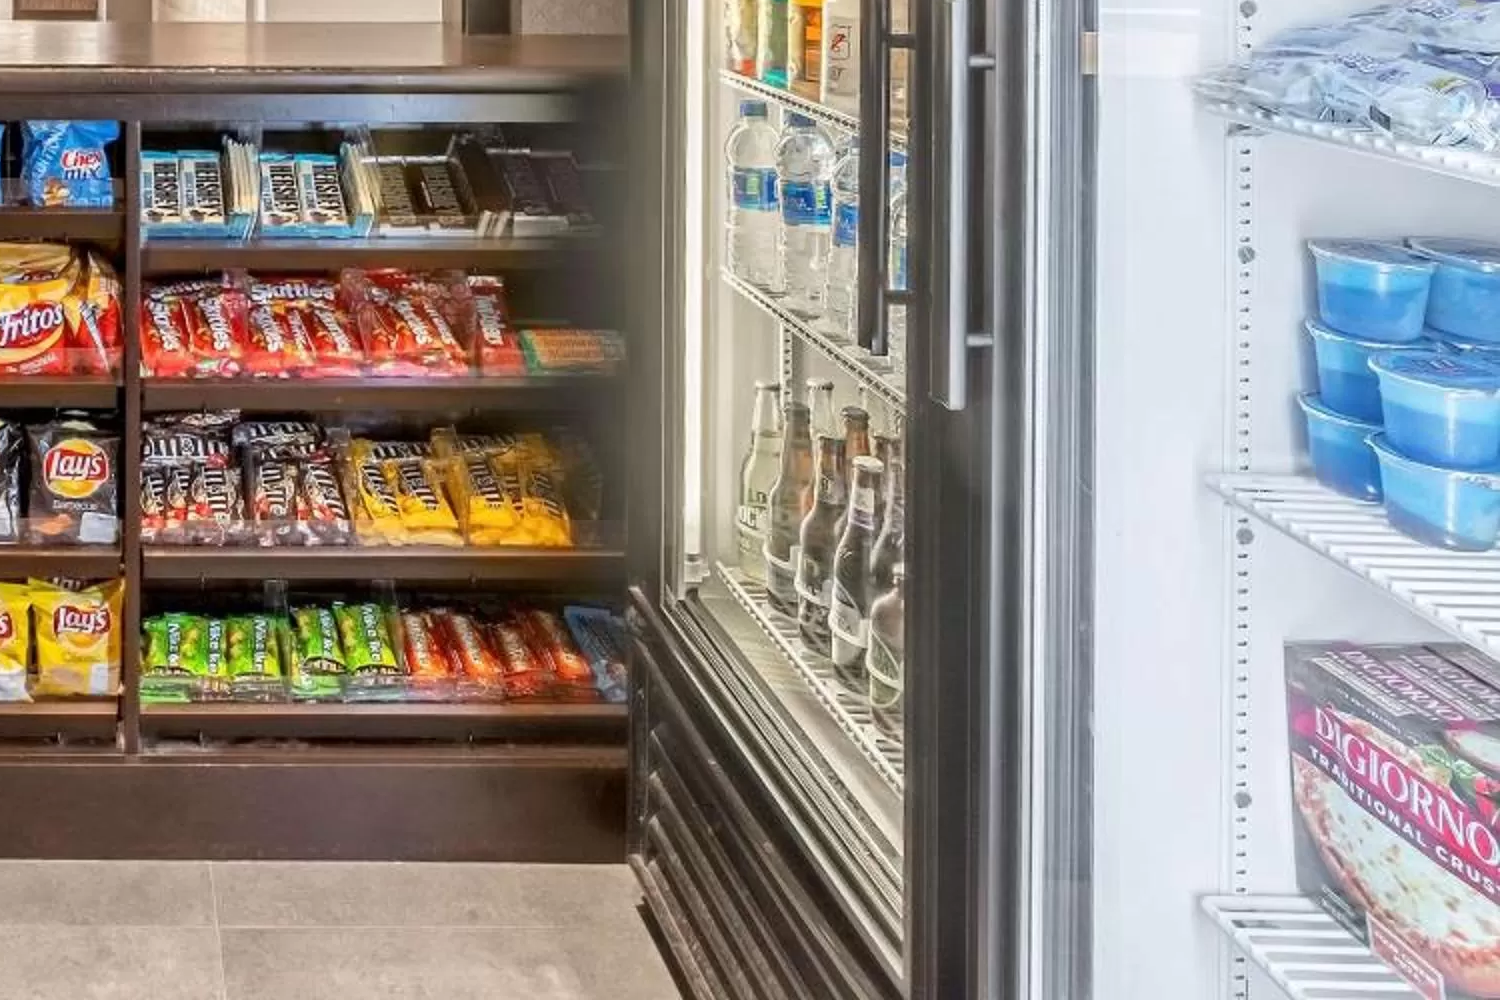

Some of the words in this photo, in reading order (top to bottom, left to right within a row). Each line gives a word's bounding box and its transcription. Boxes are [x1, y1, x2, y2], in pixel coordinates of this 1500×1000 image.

[50, 450, 104, 480] Lay's
[57, 603, 108, 633] Lay's
[1308, 744, 1427, 848] TRADITIONAL
[1315, 706, 1500, 867] DIGIORNO
